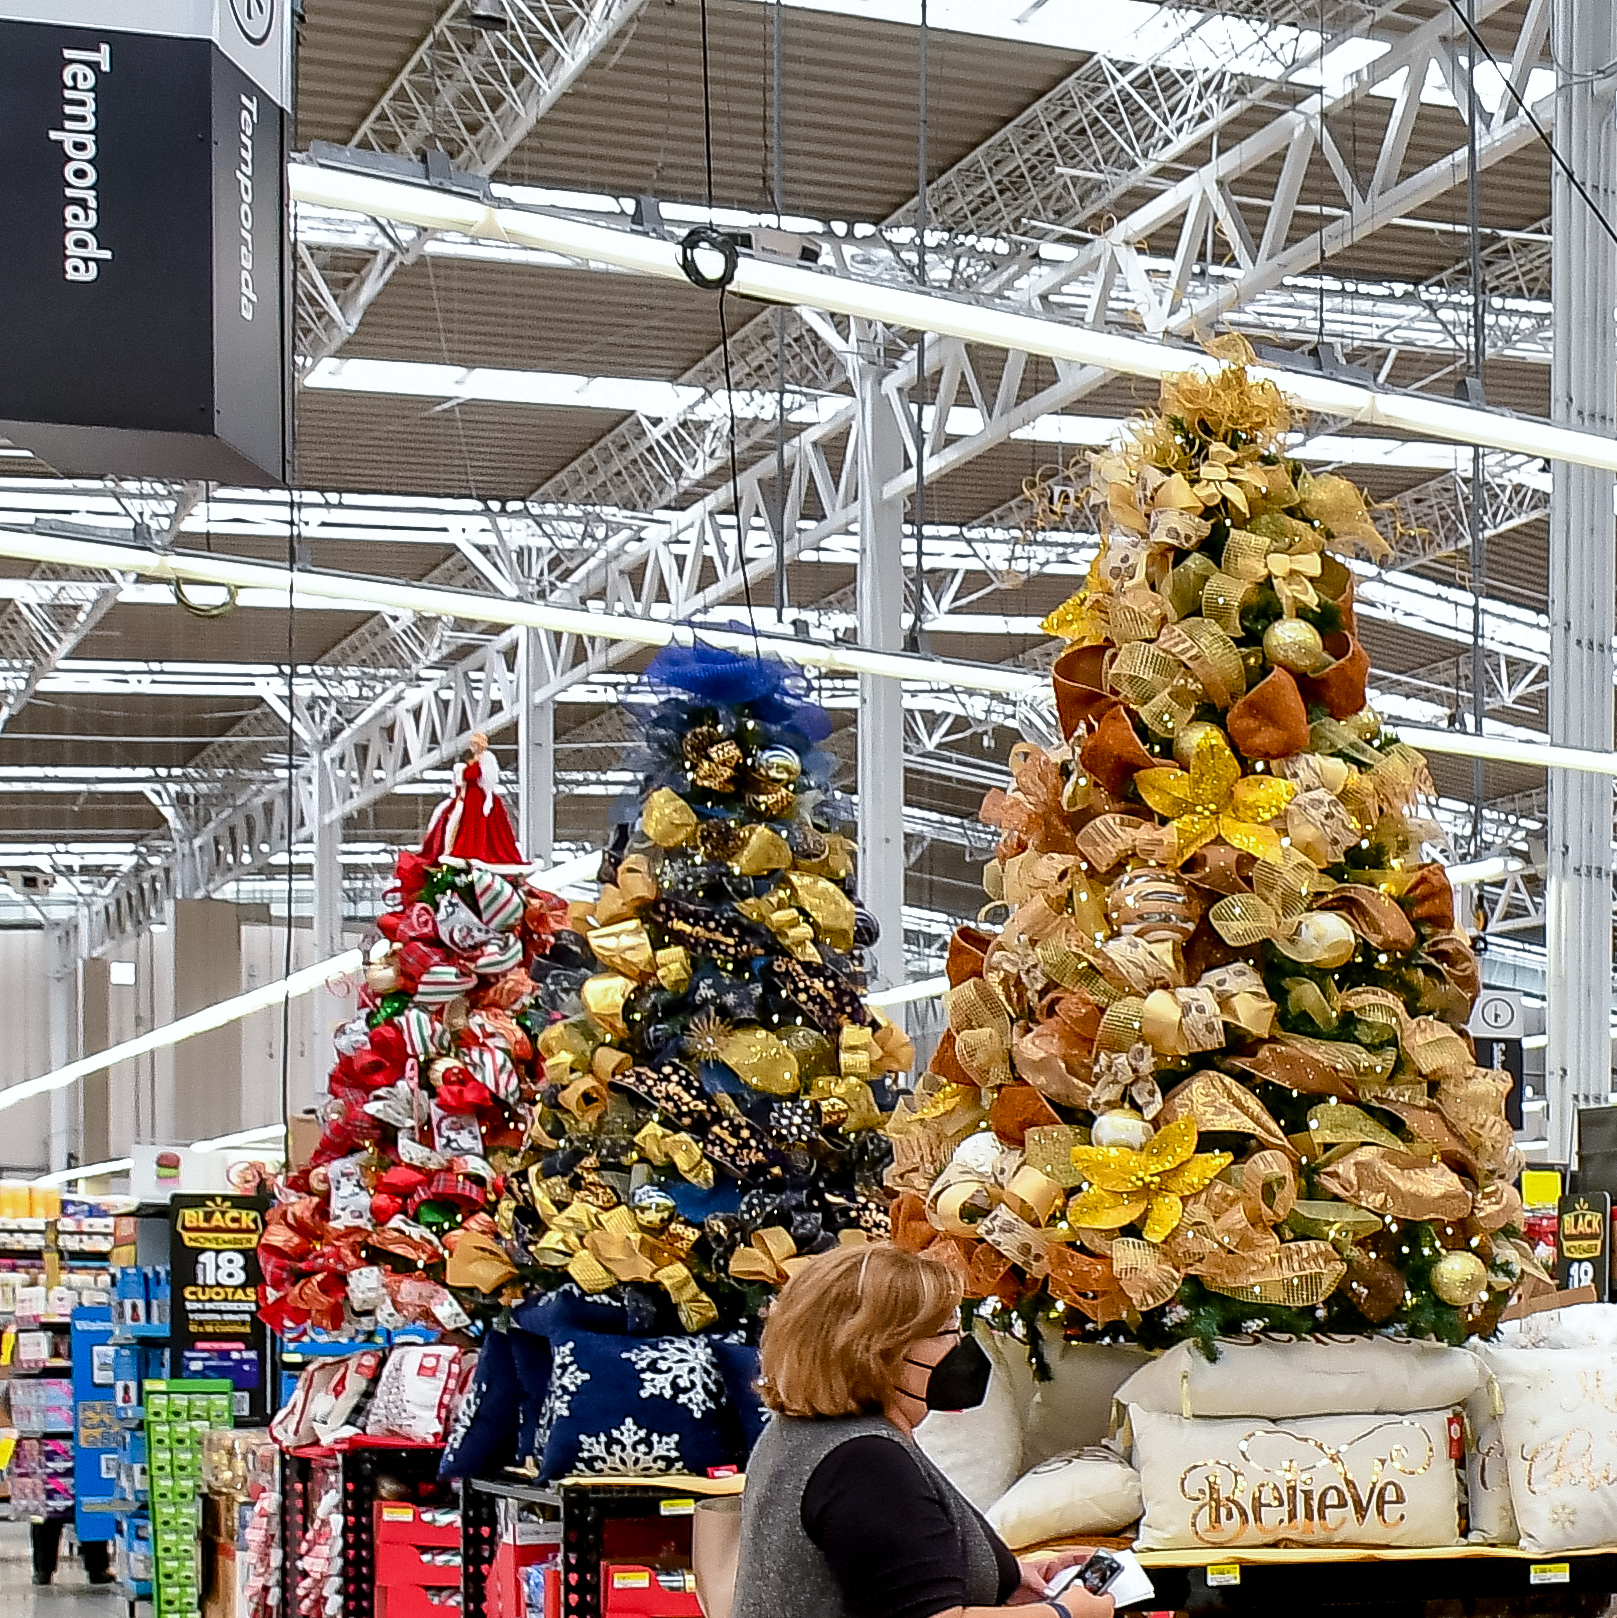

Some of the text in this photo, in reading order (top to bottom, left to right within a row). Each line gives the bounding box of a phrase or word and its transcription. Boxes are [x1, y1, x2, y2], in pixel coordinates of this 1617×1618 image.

[48, 43, 113, 282] Temporada
[235, 93, 258, 321] Temporada
[184, 1211, 256, 1229] BLACK
[1564, 1215, 1600, 1235] BLACK
[198, 1251, 246, 1286] 18
[183, 1286, 257, 1301] CUOTAS
[1178, 1421, 1435, 1545] Believe
